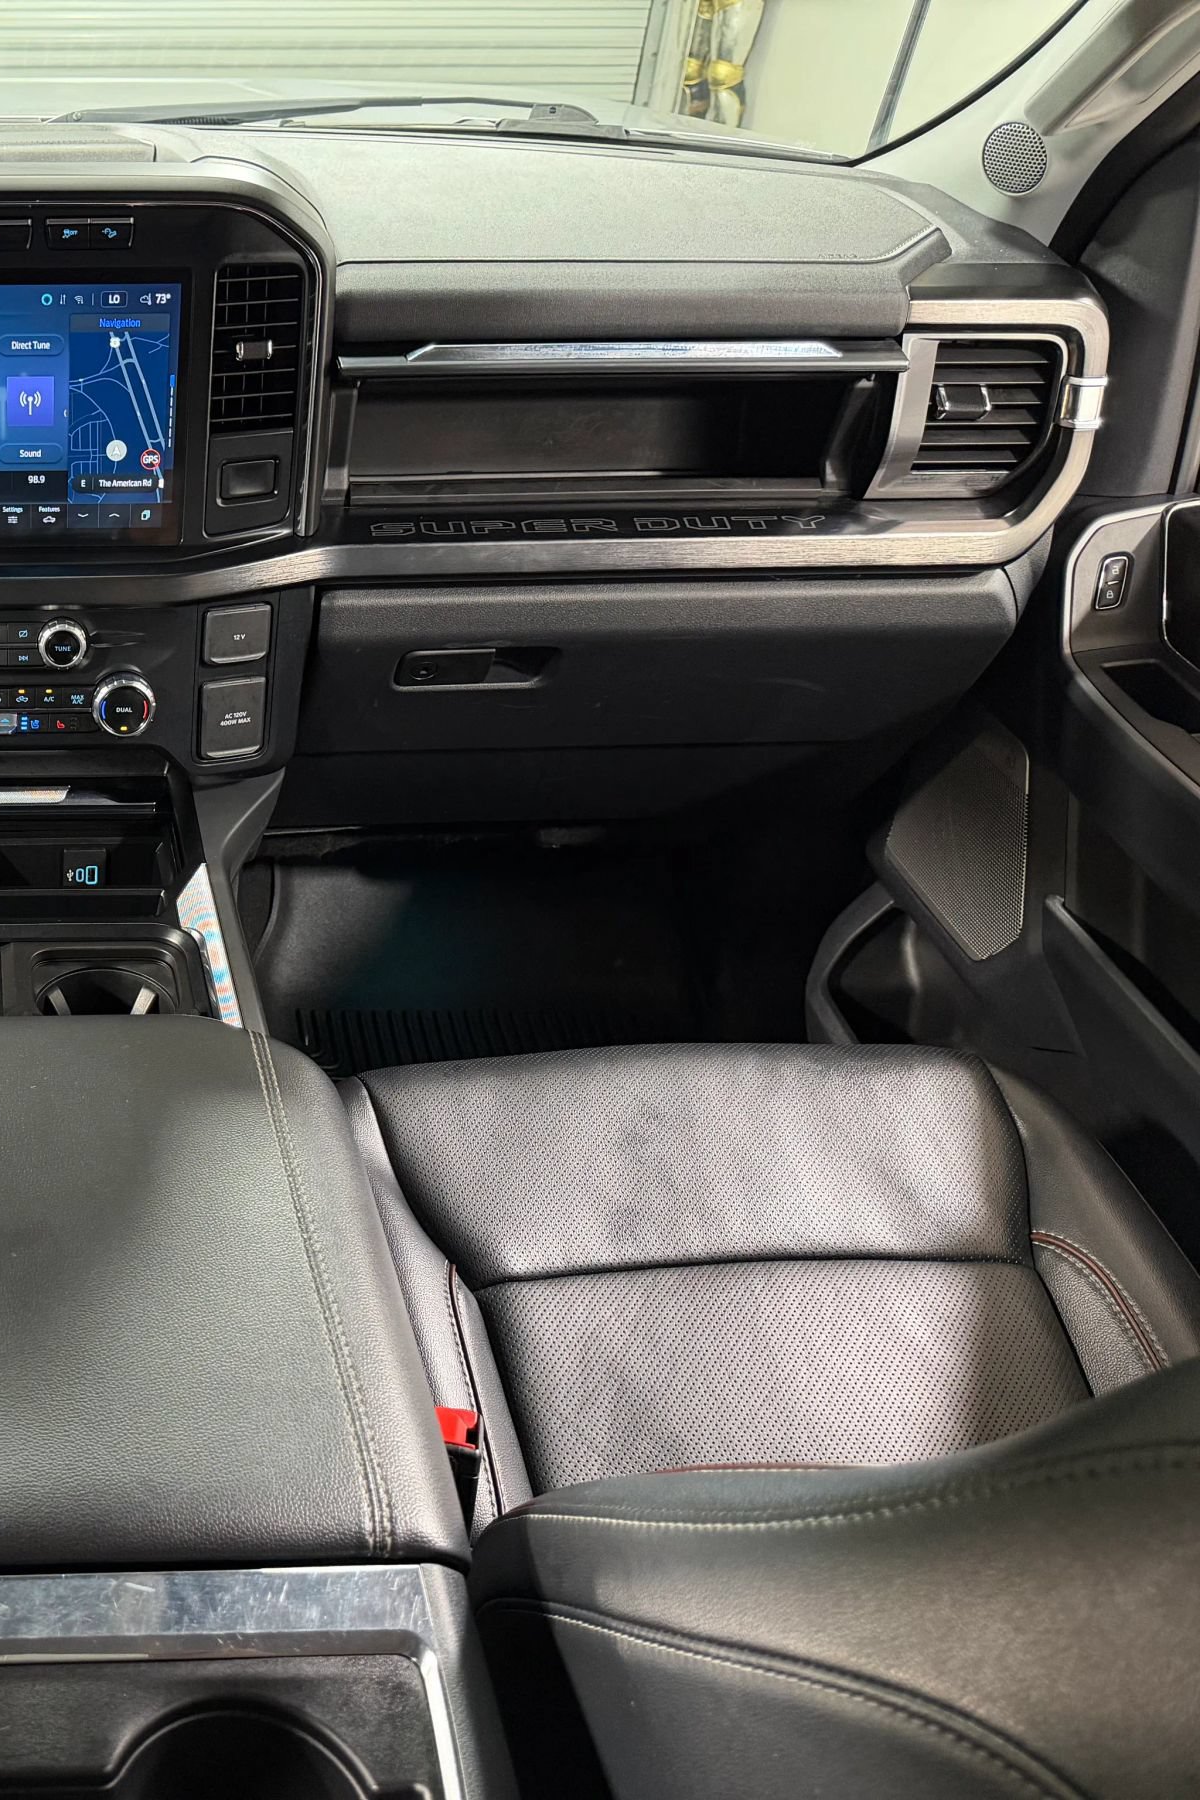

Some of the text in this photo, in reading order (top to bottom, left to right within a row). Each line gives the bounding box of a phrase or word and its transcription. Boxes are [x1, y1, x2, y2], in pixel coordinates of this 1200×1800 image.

[108, 294, 120, 304] LO
[155, 293, 171, 304] 73°
[99, 318, 141, 328] Navigation
[11, 341, 51, 350] Direct Tune
[19, 449, 42, 458] Sound
[142, 454, 159, 464] GPS
[27, 475, 46, 484] 98.9
[99, 478, 152, 487] The American Rd
[2, 506, 24, 514] Settings
[370, 515, 826, 536] SUPER DUTY
